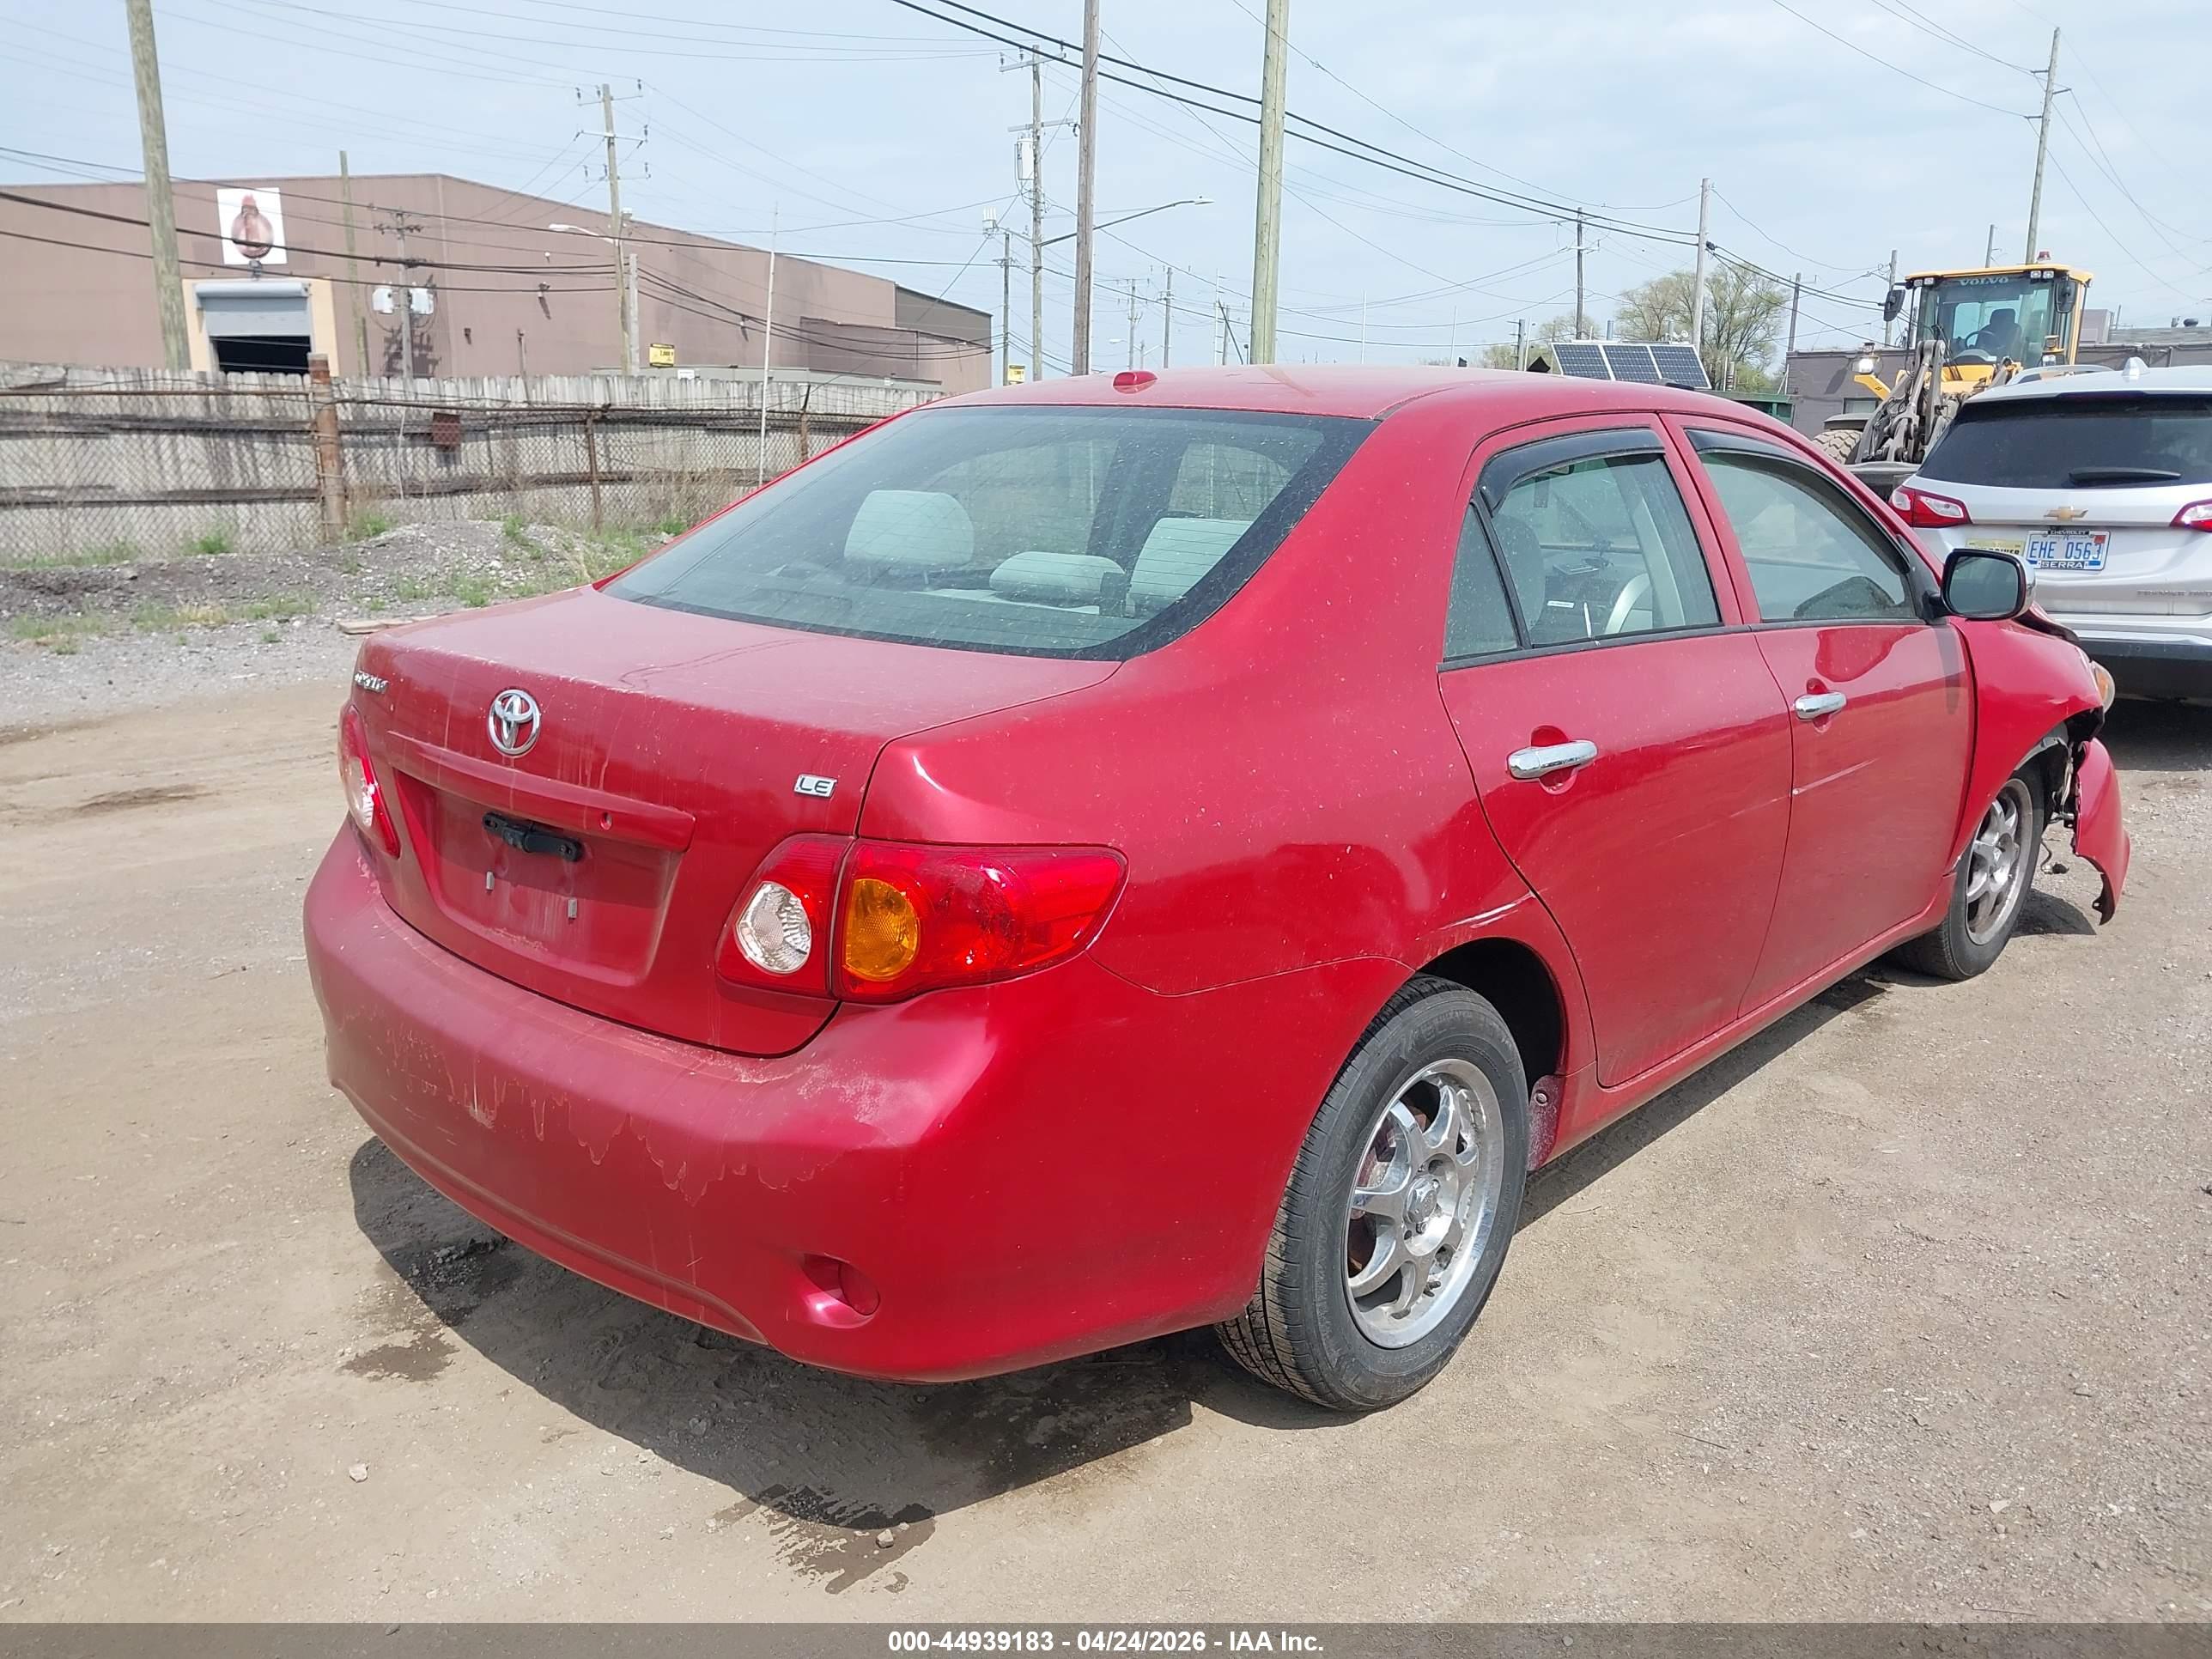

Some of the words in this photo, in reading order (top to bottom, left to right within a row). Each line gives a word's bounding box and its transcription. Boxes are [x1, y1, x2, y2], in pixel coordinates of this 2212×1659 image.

[1960, 276, 2008, 286] VOLVO
[2029, 541, 2057, 558] EHE
[2065, 542, 2102, 559] 0563
[799, 776, 831, 794] LE
